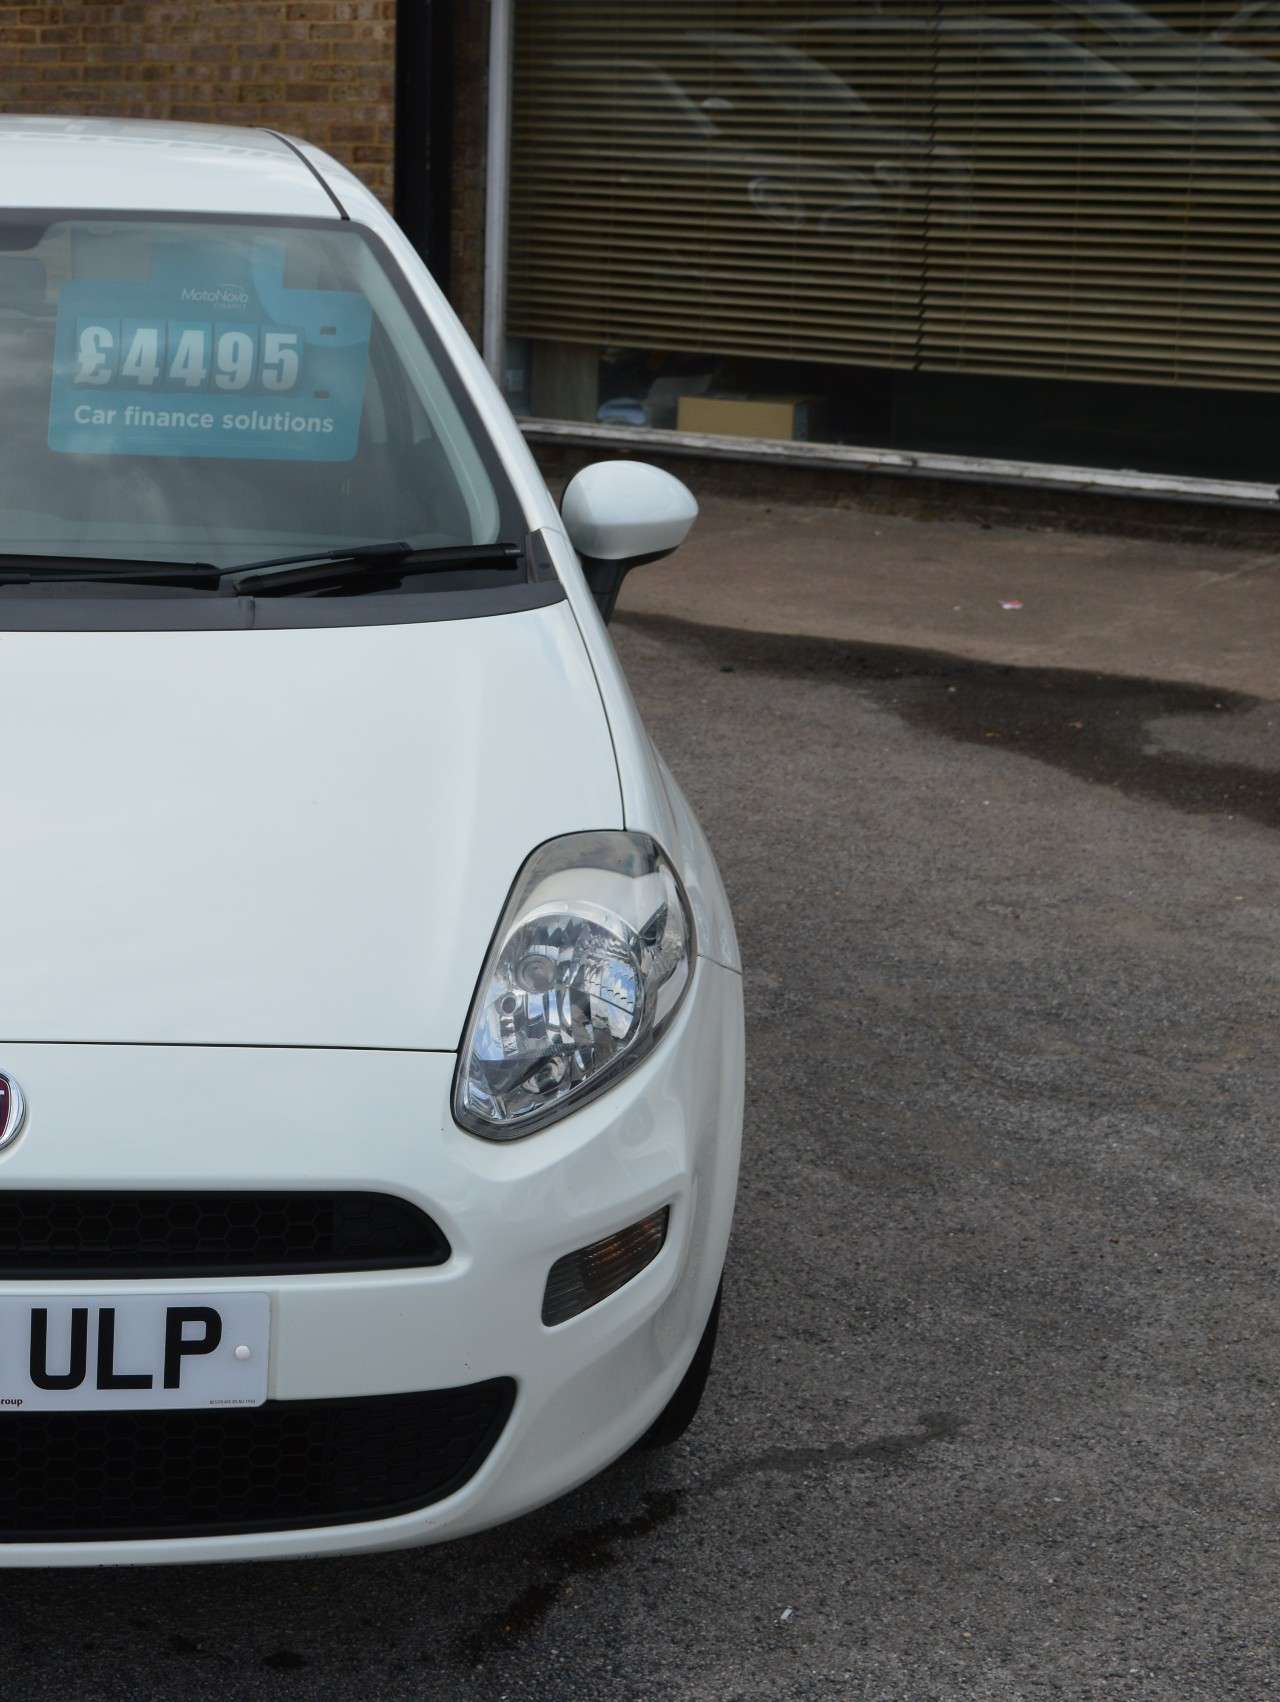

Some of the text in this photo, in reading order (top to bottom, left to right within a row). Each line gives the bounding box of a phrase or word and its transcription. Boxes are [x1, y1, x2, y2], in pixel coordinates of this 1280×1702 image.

[74, 325, 300, 392] £4495
[74, 404, 334, 433] Car finance solutions
[29, 1306, 222, 1390] ULP
